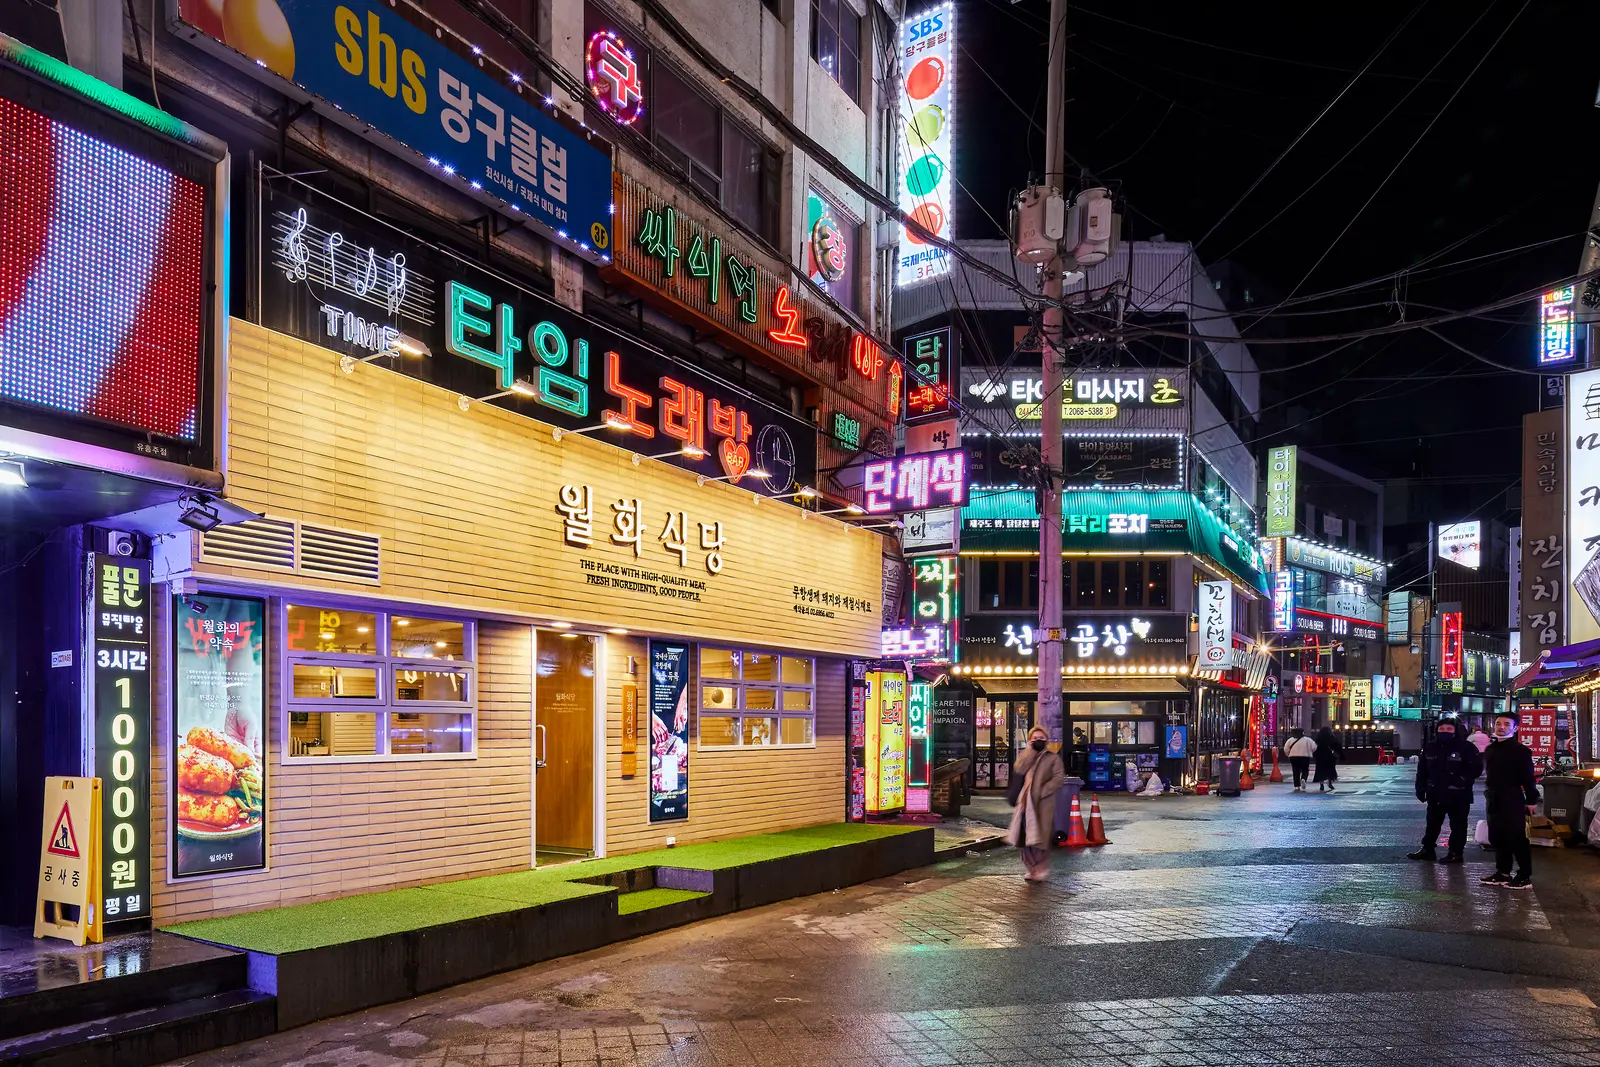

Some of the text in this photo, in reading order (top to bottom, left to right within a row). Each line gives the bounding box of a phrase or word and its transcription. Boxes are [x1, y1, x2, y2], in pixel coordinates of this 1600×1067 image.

[910, 13, 943, 42] SBS
[906, 31, 947, 57] 당구클럽
[599, 39, 642, 108] 구
[335, 6, 567, 204] sbs 당구클럽
[486, 166, 513, 191] 최신시설
[520, 185, 539, 206] 국제식
[555, 207, 568, 222] 설치
[594, 225, 606, 245] 3F
[639, 206, 757, 323] 싸이언
[320, 305, 400, 357] TIME
[1546, 306, 1569, 358] 노래방
[446, 280, 752, 484] 타임 노래방
[1077, 378, 1144, 403] 마사지
[1105, 407, 1114, 415] 3F
[136, 443, 168, 456] 유흥주점
[727, 452, 744, 467] BAR
[1274, 449, 1292, 472] 타이
[1537, 432, 1558, 493] 민속식당
[865, 453, 964, 512] 단체석
[1273, 481, 1292, 516] 마사지
[555, 484, 727, 576] 월화식당
[969, 519, 992, 528] 제주도
[580, 559, 596, 571] THE
[597, 563, 620, 575] PLACE
[620, 567, 640, 579] WITH
[641, 571, 689, 587] HIGH-QUALITY
[586, 574, 610, 586] FRESH
[611, 578, 658, 596] INGREDIENTS,
[659, 586, 676, 598] GOOD
[793, 586, 872, 612] 무항생제 돼지와 제철식재료
[1528, 535, 1562, 645] 잔치집
[102, 613, 143, 634] 뮤직타운
[202, 619, 239, 635] 월화의
[209, 636, 234, 652] 약속
[97, 649, 148, 671] 3시간
[881, 699, 903, 726] 노래
[111, 677, 137, 890] 10000원
[209, 852, 234, 862] 월화식당
[44, 864, 81, 888] 공사중
[105, 895, 141, 916] 평일
